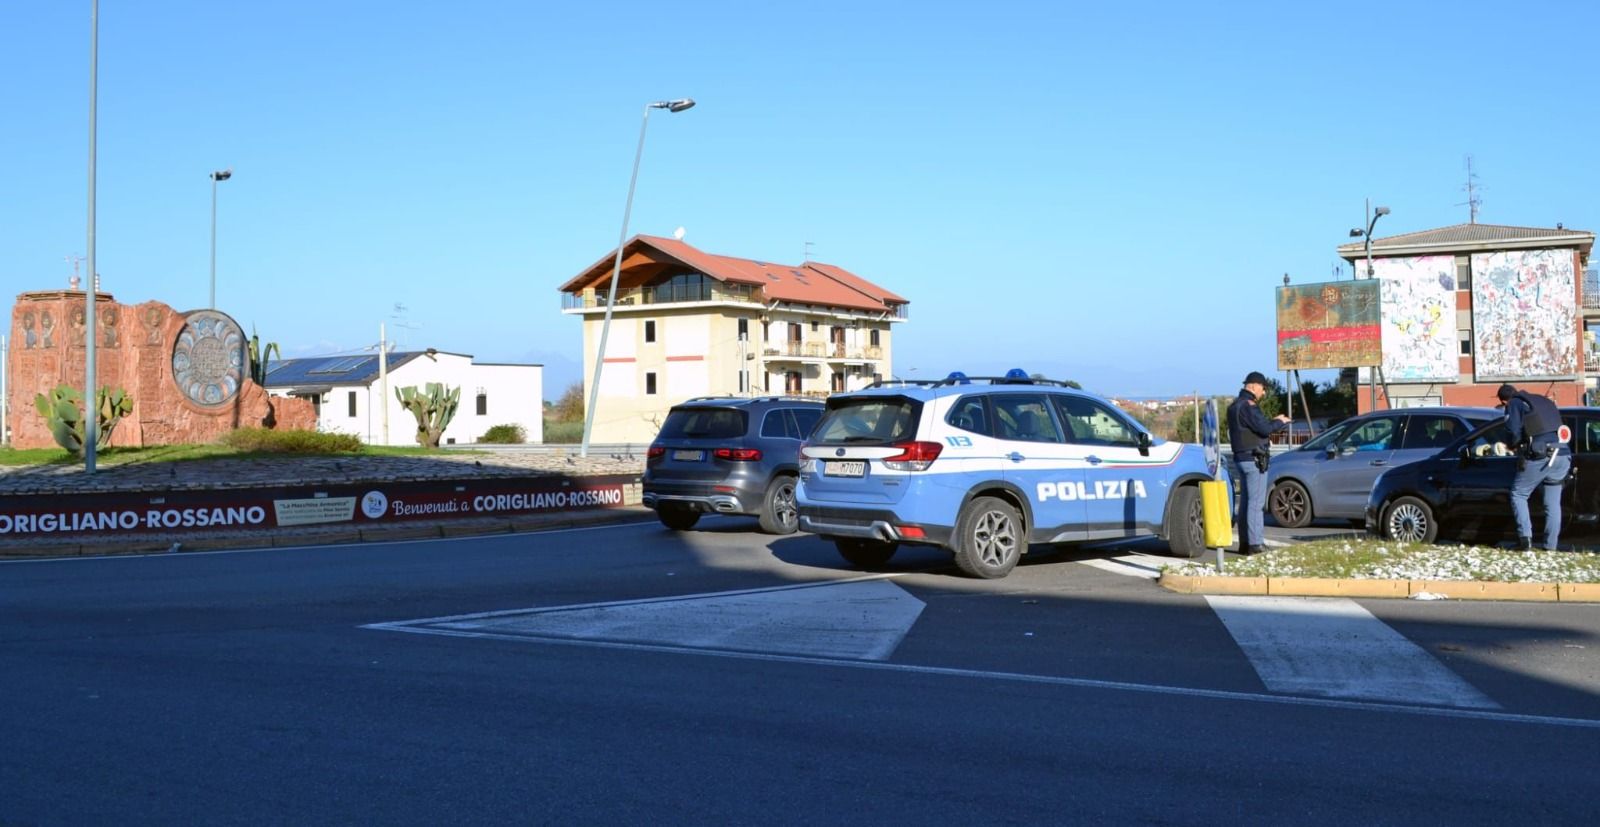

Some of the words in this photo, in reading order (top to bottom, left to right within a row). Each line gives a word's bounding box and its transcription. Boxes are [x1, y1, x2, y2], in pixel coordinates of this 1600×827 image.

[944, 435, 973, 447] 113
[392, 498, 458, 516] Benvenuti
[461, 501, 470, 512] a
[473, 489, 621, 513] CORIGLIANO-ROSSANO
[1036, 479, 1147, 503] POLIZIA
